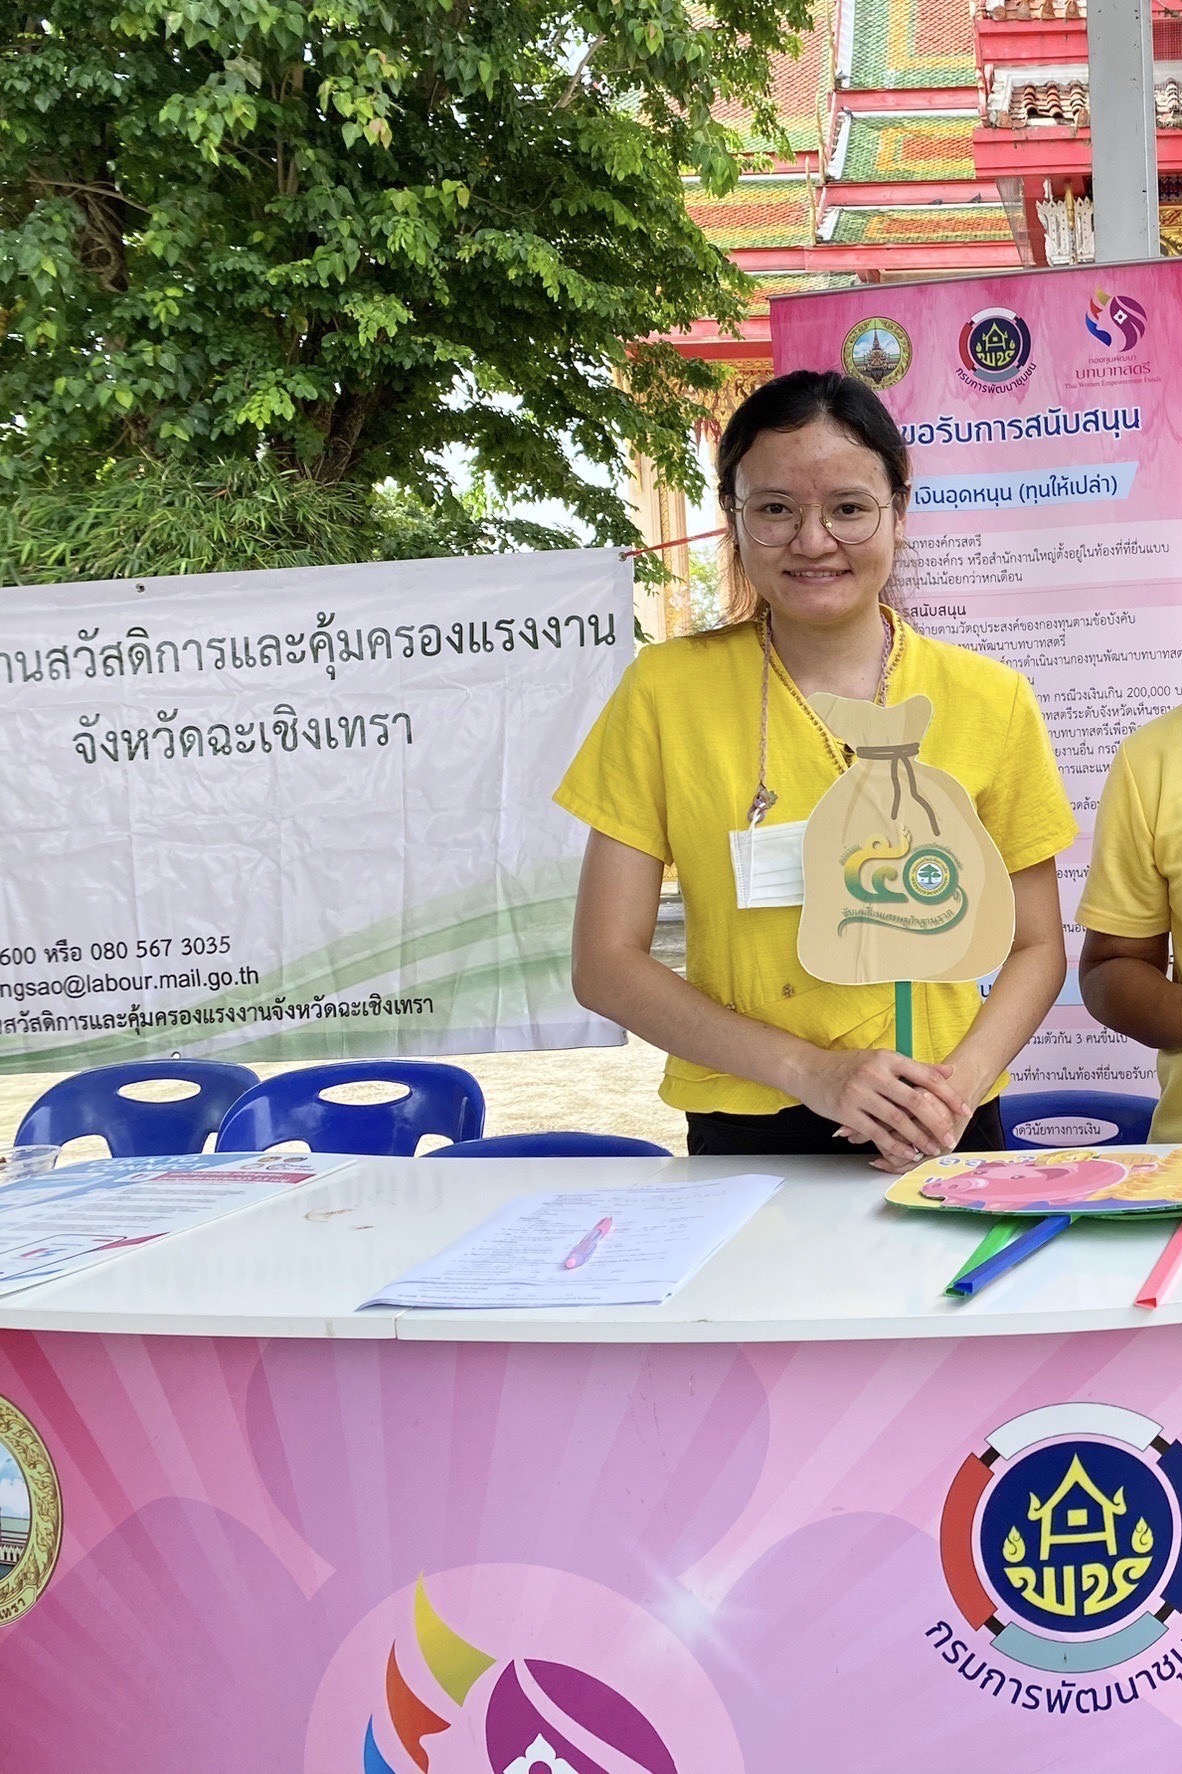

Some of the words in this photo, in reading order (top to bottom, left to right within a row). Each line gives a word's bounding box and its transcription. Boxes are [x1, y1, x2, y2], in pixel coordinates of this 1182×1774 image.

[956, 362, 1037, 394] กรมการพัฒนาชุมชน
[1075, 361, 1151, 380] บทบาทสตรี
[914, 485, 1012, 509] เงินอุดหนุน
[1018, 474, 1118, 505] (ทุนให้เปล่า)
[1126, 684, 1171, 700] 200,000
[72, 702, 414, 765] จังหวัดฉะเชิงเทรา
[0, 946, 37, 966] 600
[44, 938, 83, 964] หรือ
[91, 941, 128, 960] 080
[136, 938, 172, 958] 567
[181, 935, 232, 956] 3035
[0, 966, 260, 1001] ngsao@labour.mail.go.th
[1076, 1033, 1083, 1044] 3
